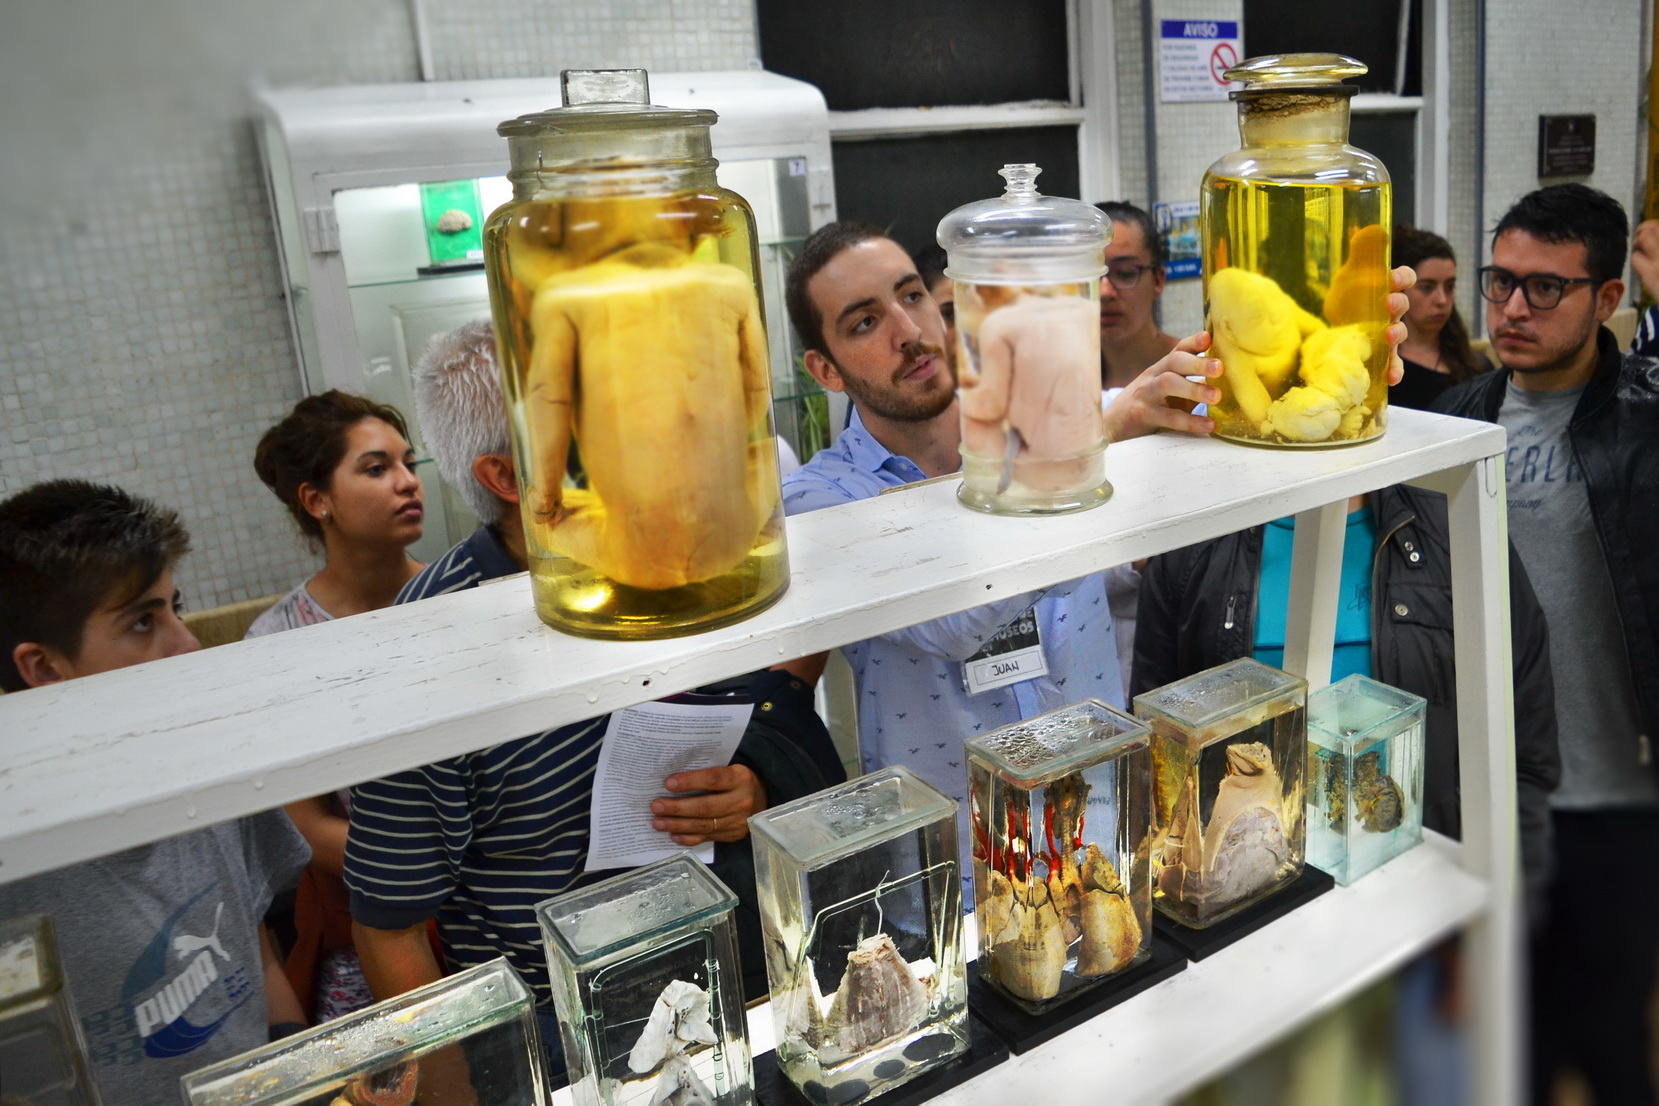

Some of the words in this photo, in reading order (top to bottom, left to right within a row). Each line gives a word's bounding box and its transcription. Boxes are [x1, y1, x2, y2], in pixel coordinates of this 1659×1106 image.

[1183, 22, 1218, 37] AVISO
[996, 621, 1035, 640] USEOS
[992, 660, 1020, 677] JUAN
[134, 950, 219, 1038] PUMA
